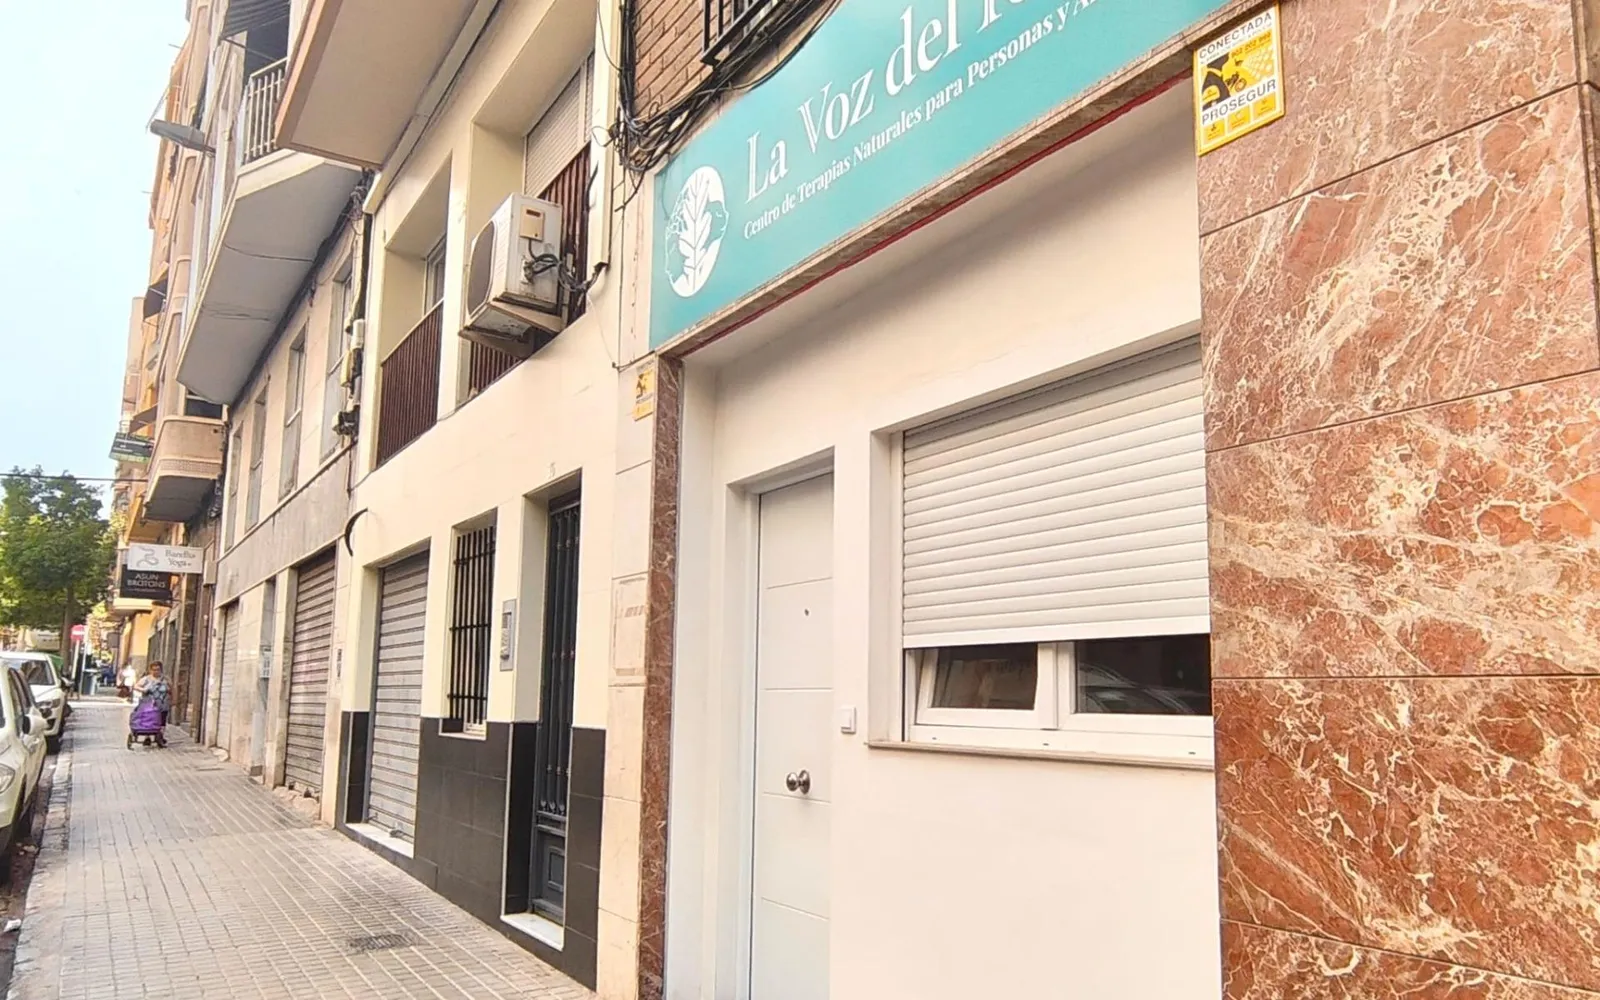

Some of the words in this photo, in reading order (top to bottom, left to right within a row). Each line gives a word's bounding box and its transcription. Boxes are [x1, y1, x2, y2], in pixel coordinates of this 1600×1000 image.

[1199, 12, 1272, 59] CONECTADA
[744, 205, 780, 240] Centro
[781, 192, 797, 215] de
[797, 155, 851, 204] Terapias
[853, 106, 922, 167] Naturales
[925, 77, 963, 121] para
[967, 13, 1054, 89] Personas
[1056, 1, 1071, 31] y
[745, 130, 789, 204] La
[797, 68, 875, 155] Voz
[885, 0, 962, 96] del
[1202, 79, 1277, 126] PROSEGUR
[127, 580, 166, 588] BROTONS
